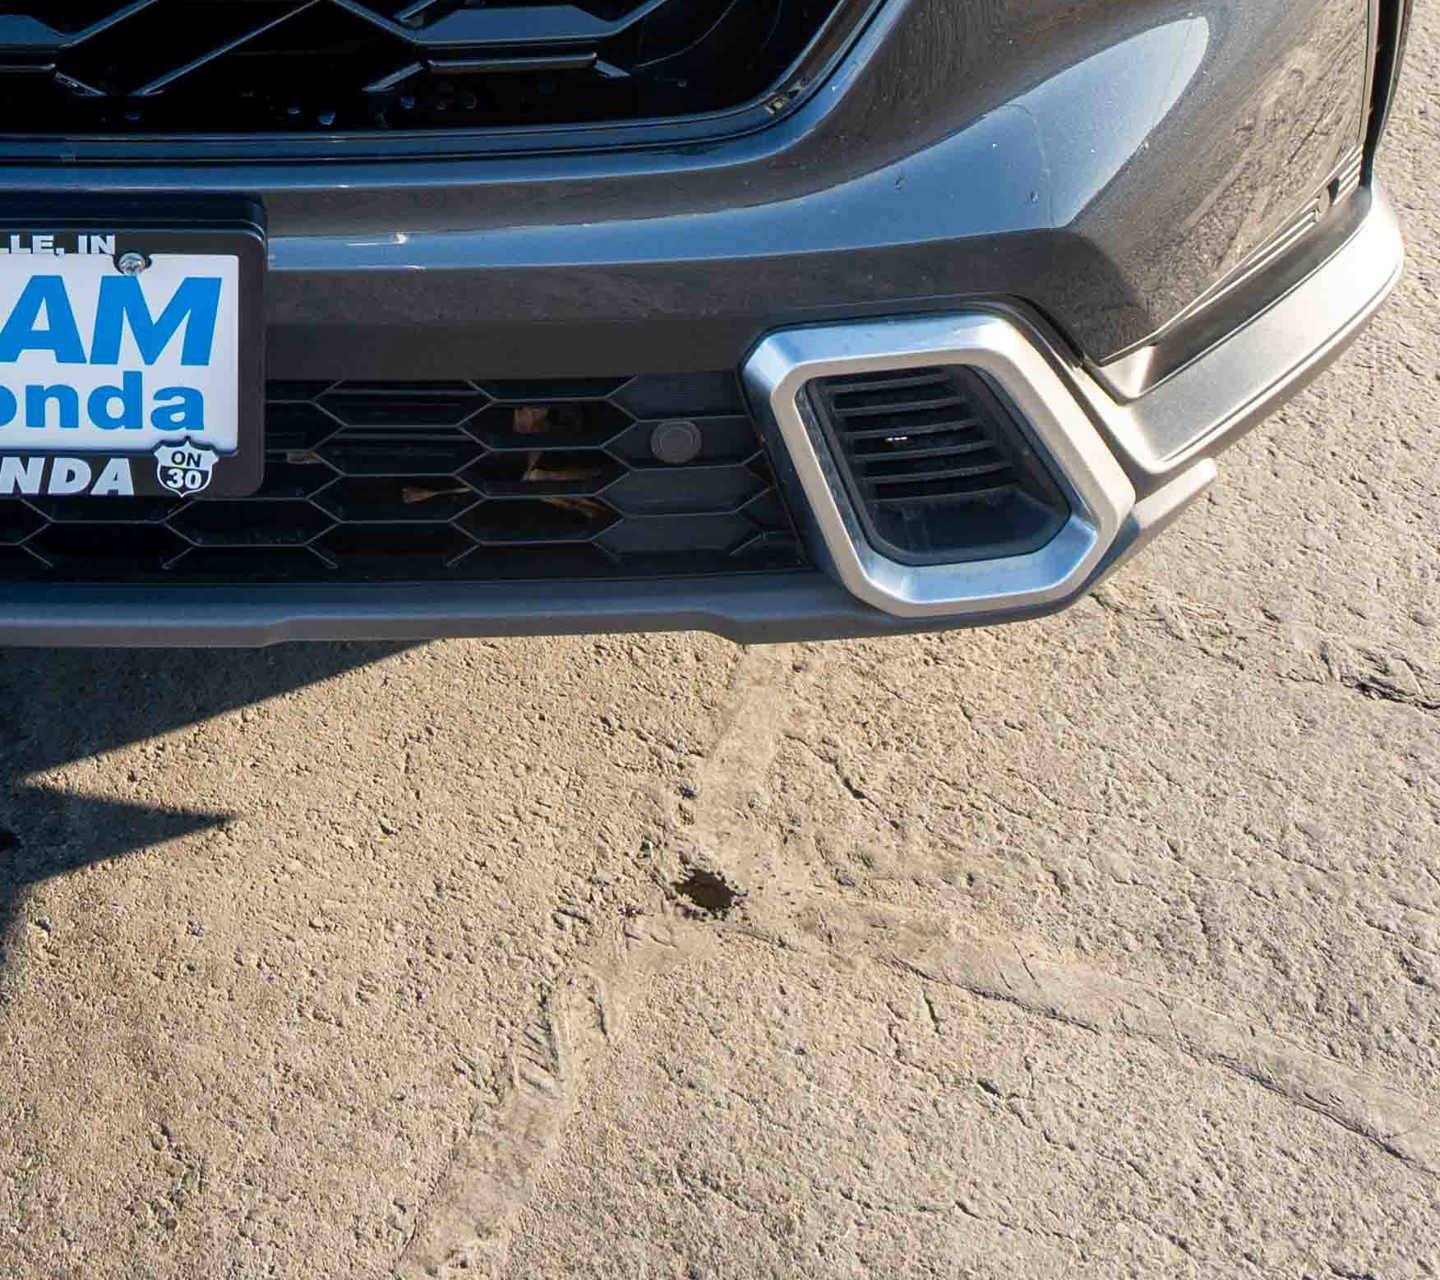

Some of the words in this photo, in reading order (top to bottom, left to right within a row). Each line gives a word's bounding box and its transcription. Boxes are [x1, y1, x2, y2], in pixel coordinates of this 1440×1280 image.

[77, 234, 117, 255] IN
[170, 450, 202, 468] ON
[166, 468, 203, 490] 30
